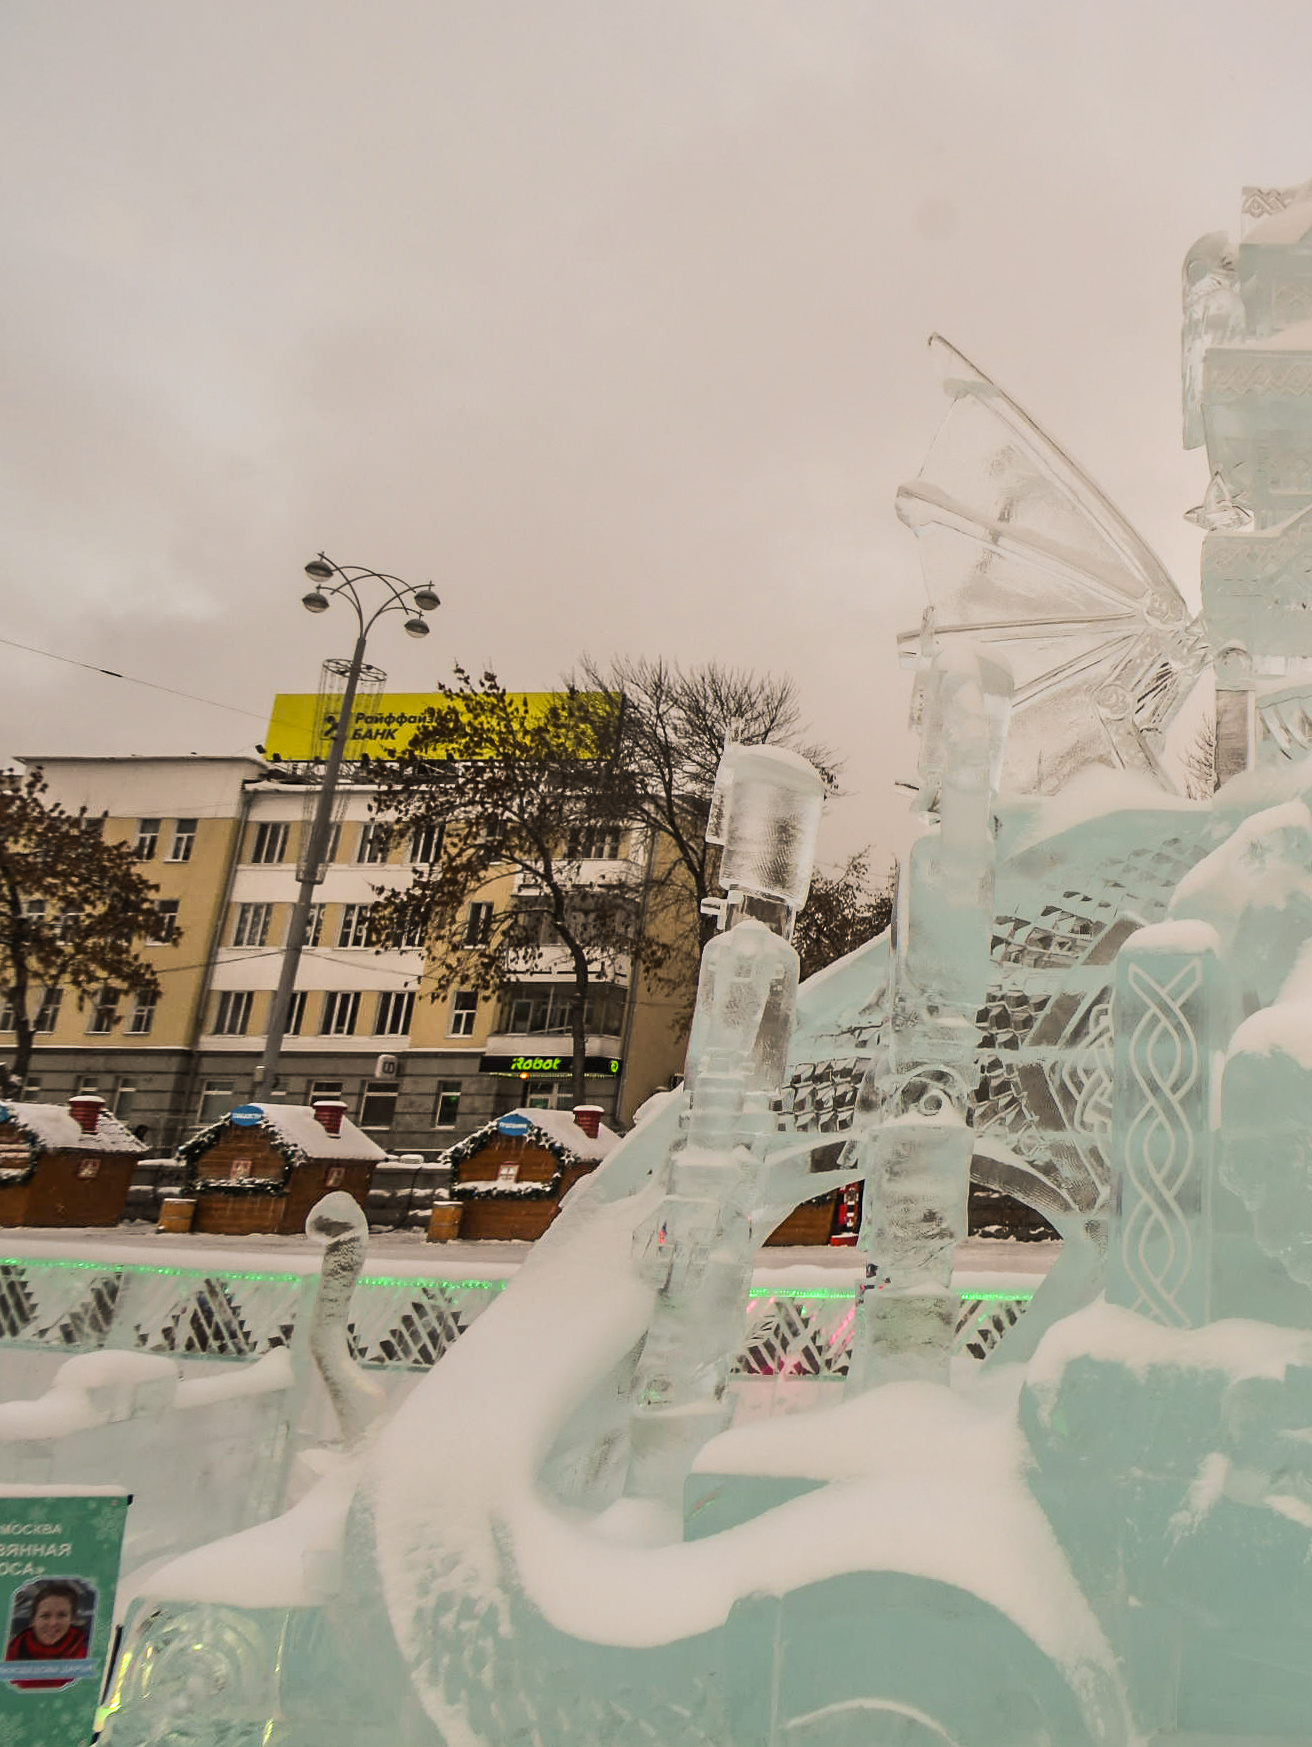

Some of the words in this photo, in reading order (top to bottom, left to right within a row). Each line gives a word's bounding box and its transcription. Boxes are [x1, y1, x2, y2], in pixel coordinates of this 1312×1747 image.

[355, 712, 451, 727] Райффайз
[351, 728, 399, 741] БАНК
[510, 1056, 561, 1070] iRobot
